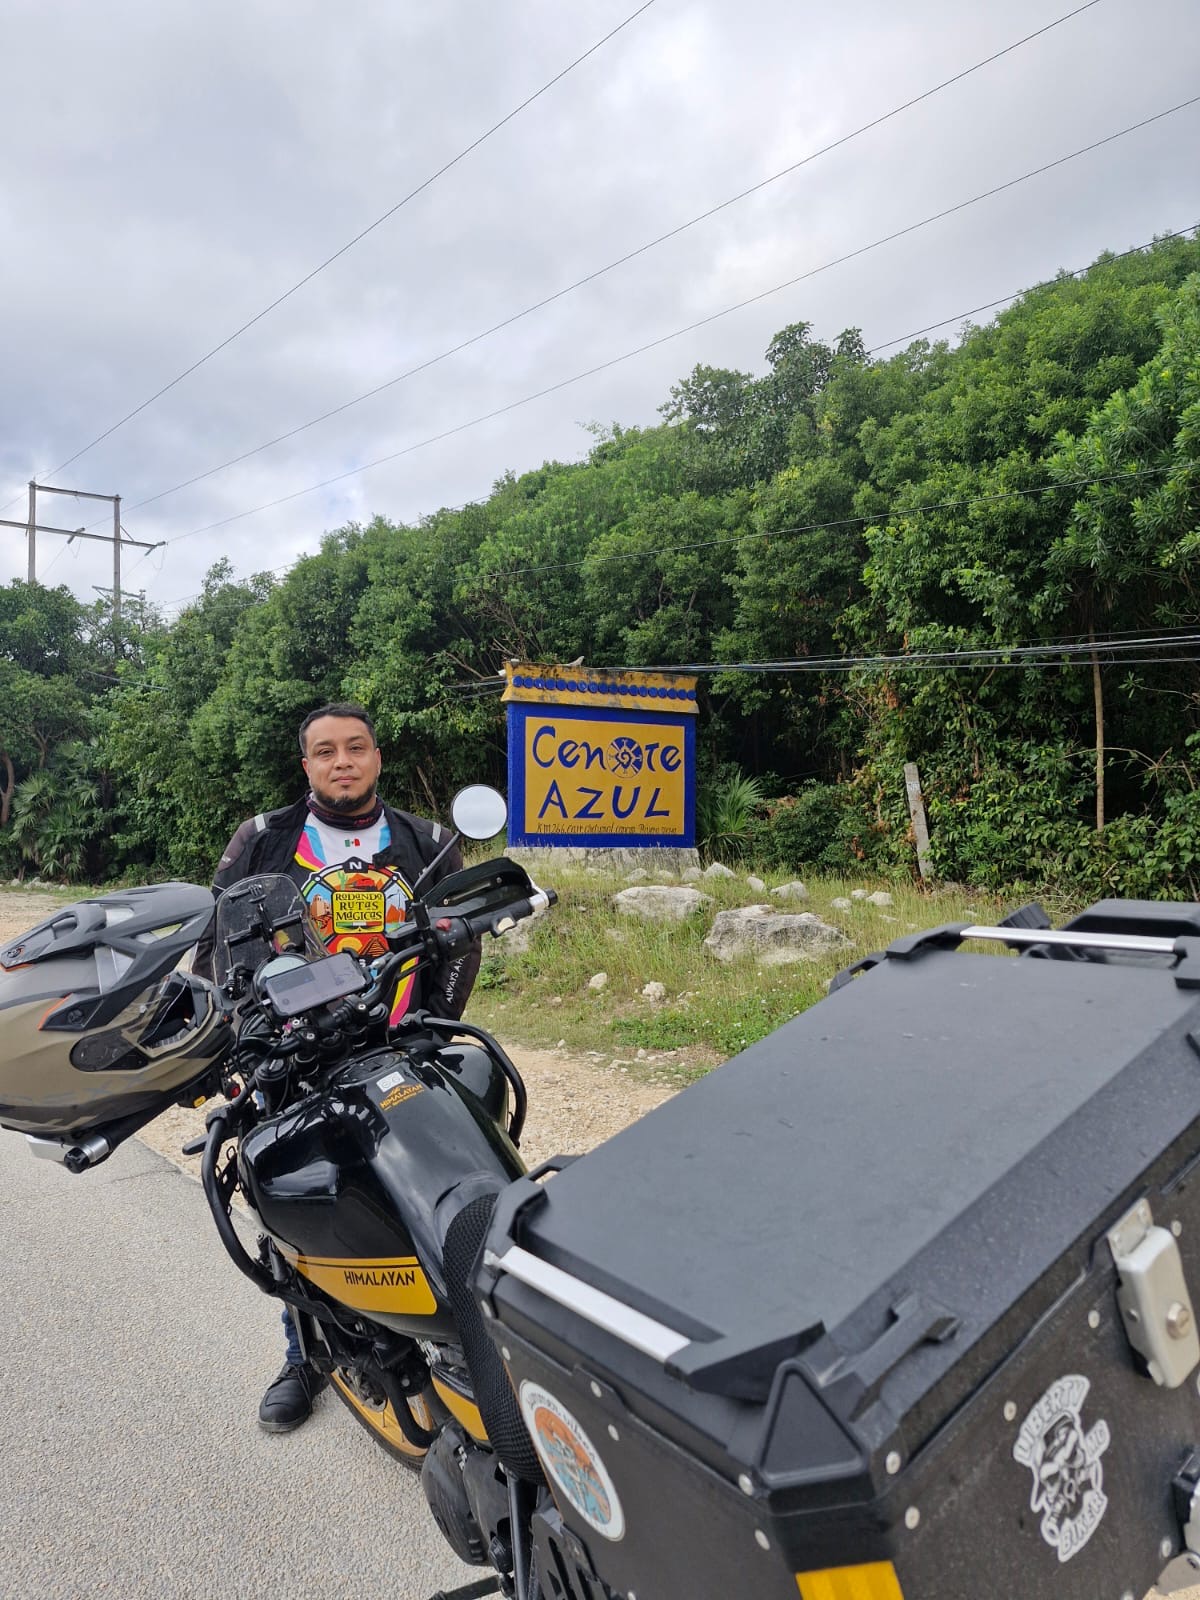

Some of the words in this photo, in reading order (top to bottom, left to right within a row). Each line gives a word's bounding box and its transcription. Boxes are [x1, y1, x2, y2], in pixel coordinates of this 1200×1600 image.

[532, 725, 682, 779] Cenote
[537, 779, 670, 819] AZUL
[349, 861, 362, 870] N
[343, 1269, 416, 1286] HIMALAYAN
[1017, 1378, 1087, 1460] LIBERTY
[1060, 1491, 1106, 1555] BIKER
